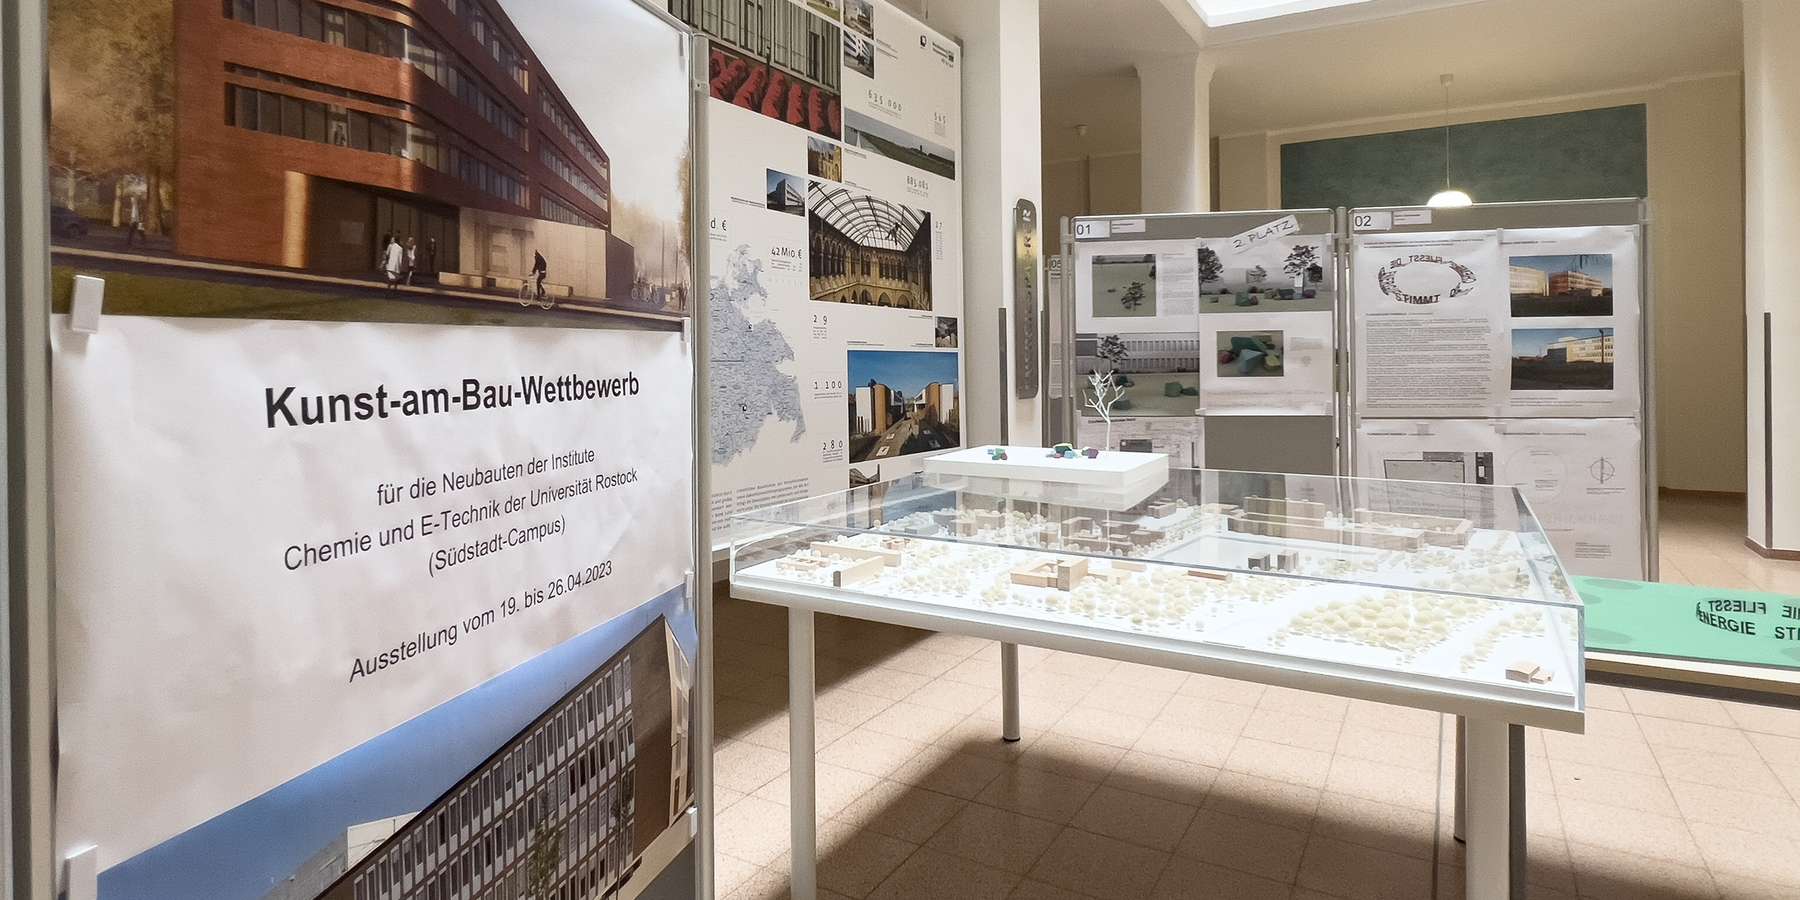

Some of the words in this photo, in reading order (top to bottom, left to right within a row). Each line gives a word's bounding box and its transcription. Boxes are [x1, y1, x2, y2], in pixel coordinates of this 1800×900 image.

[1076, 224, 1091, 236] 01
[1247, 220, 1294, 243] PLATZ
[1354, 215, 1372, 227] 02
[265, 371, 640, 428] Kunst-am-Bau-Wettbewerb
[376, 484, 404, 506] für
[409, 476, 437, 500] die
[442, 463, 524, 494] Neubauten
[526, 456, 549, 476] der
[551, 448, 595, 471] Institute
[284, 531, 373, 571] Chemie
[378, 523, 414, 547] und
[421, 499, 501, 537] E-Technik
[504, 494, 526, 515] der
[530, 478, 593, 508] Universität
[595, 467, 638, 492] Rostock
[427, 515, 567, 578] (Südstadt-Campus)
[349, 624, 458, 683] Ausstellung
[462, 610, 495, 635] vom
[500, 598, 520, 618] 19.
[524, 587, 544, 609] bis
[547, 560, 613, 601] 26.04.2023
